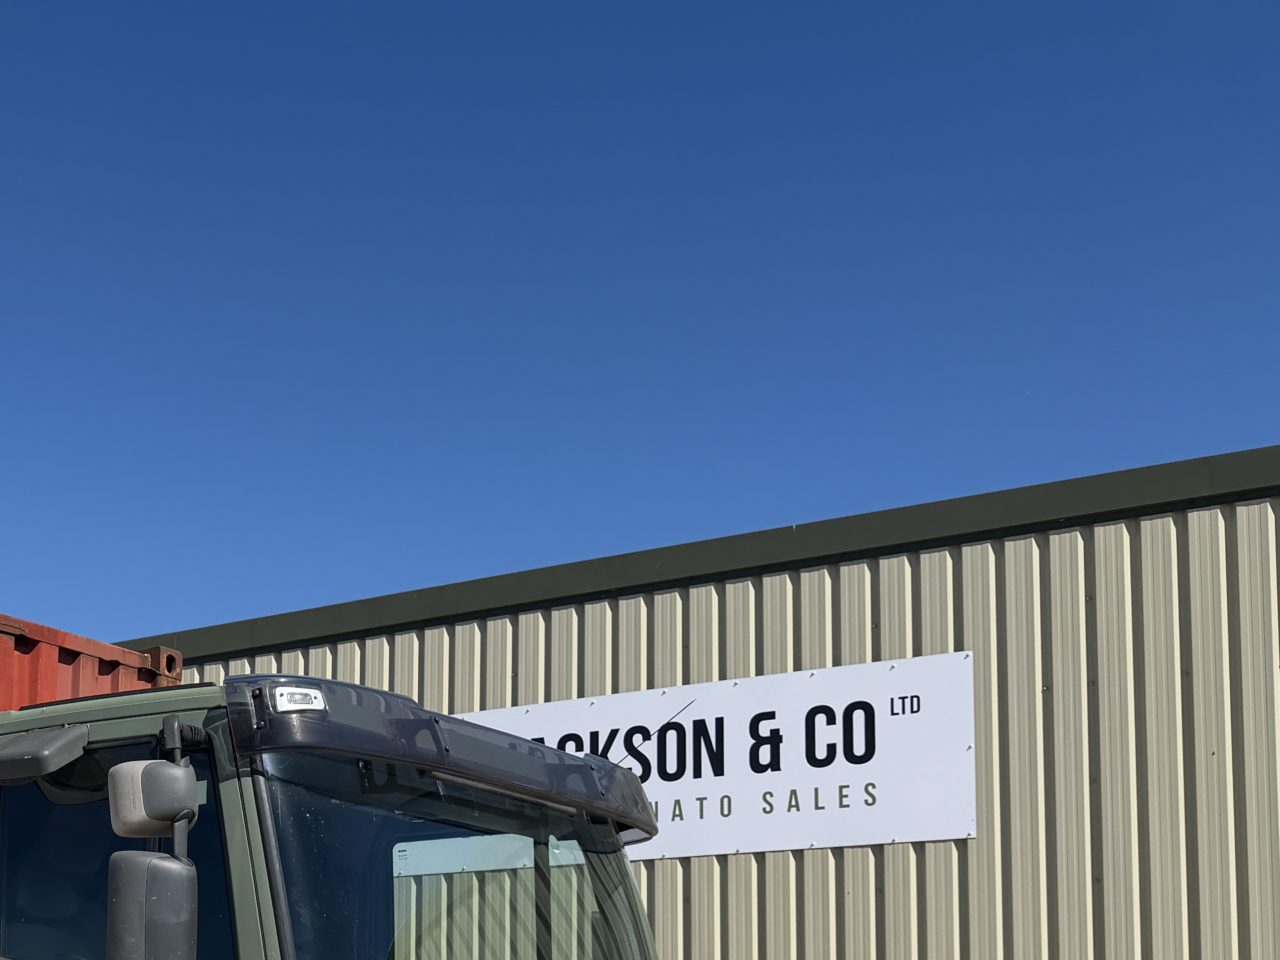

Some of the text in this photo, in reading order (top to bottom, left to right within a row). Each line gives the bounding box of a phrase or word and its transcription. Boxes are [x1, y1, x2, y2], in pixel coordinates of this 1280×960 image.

[531, 695, 922, 785] KSON & CO LTD
[761, 782, 878, 814] SALES
